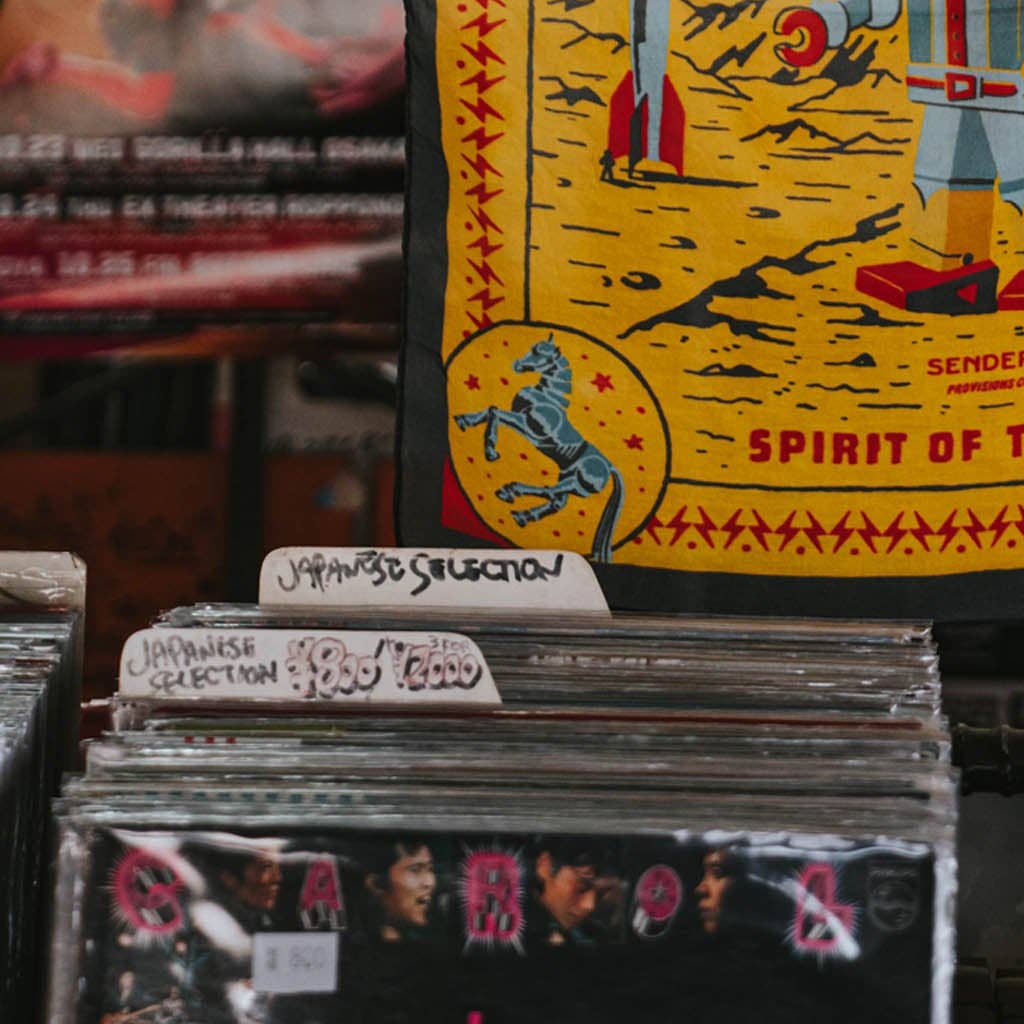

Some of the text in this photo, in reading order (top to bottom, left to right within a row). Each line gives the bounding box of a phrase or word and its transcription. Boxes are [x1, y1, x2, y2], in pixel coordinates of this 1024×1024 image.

[946, 378, 1015, 395] PROVISIONS
[748, 428, 908, 465] SPIRIT
[928, 429, 982, 464] OF
[278, 550, 564, 596] JAPANESE SELECTION
[127, 634, 256, 677] JAPANESE
[149, 660, 278, 695] SELECTION
